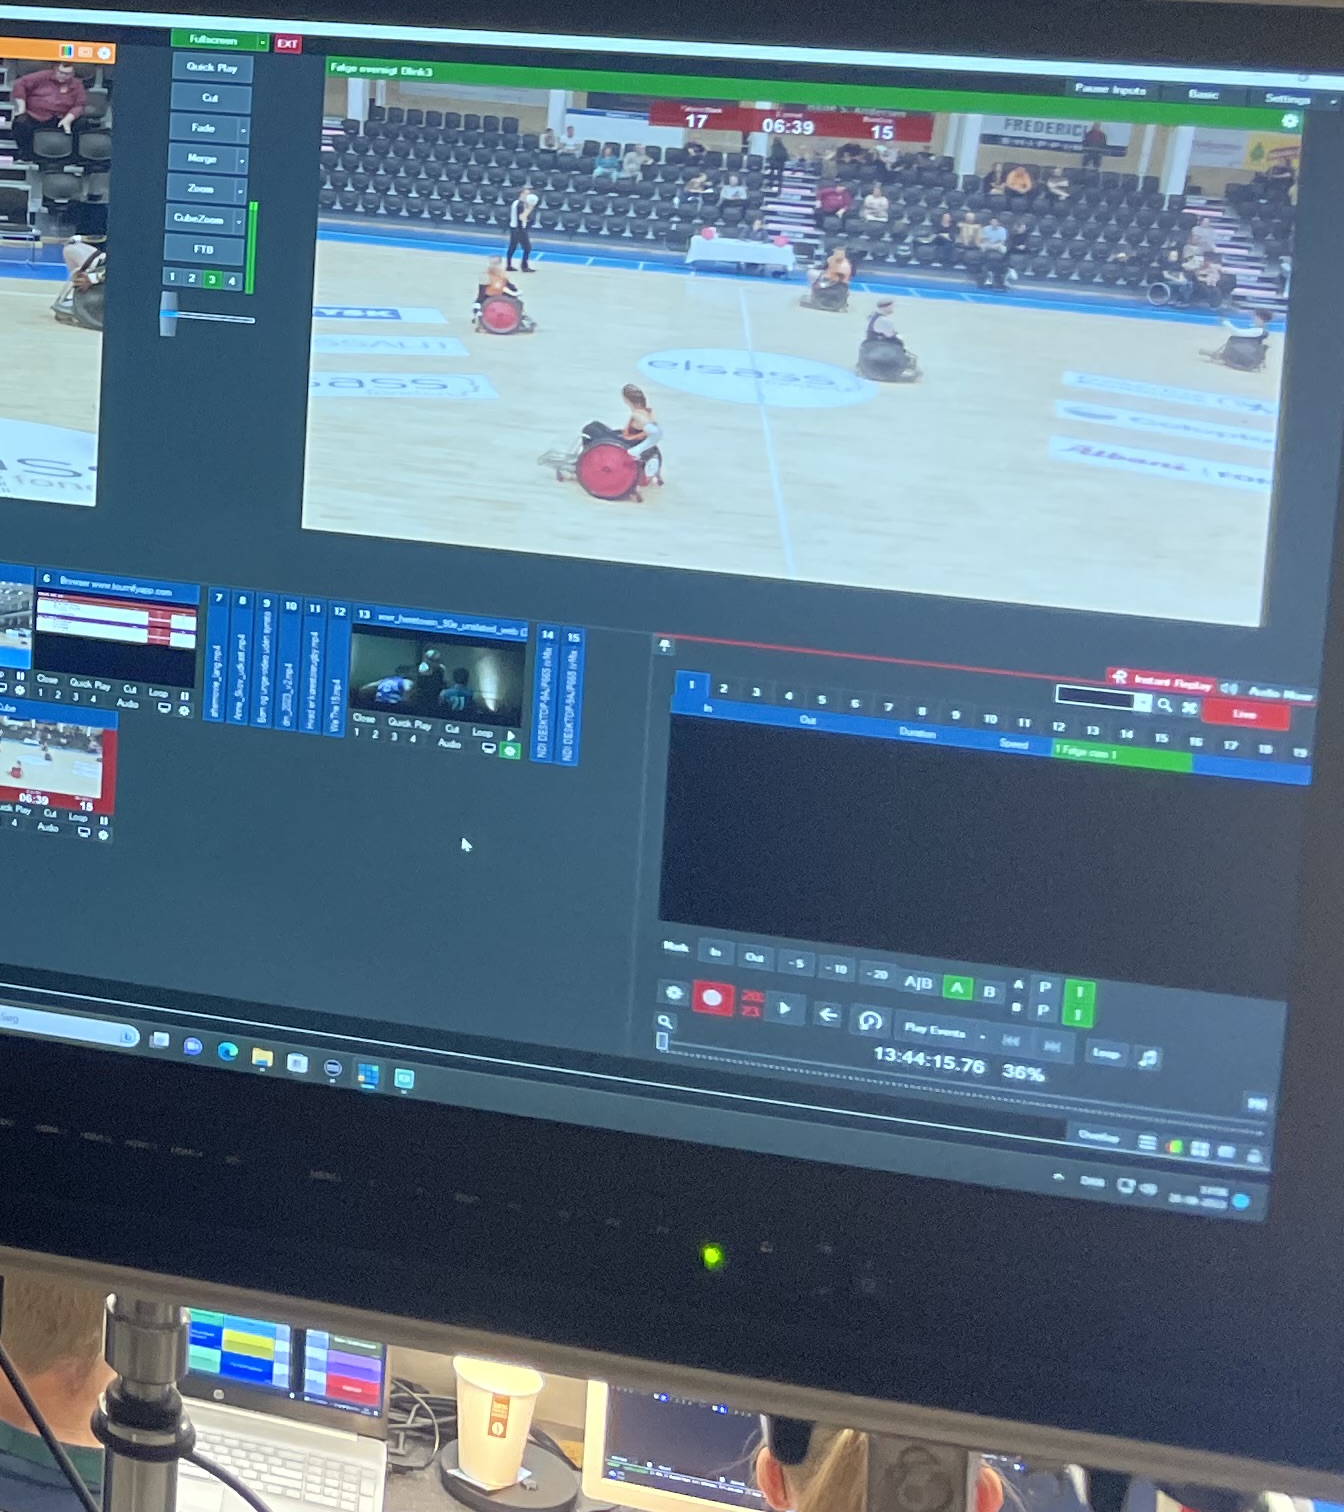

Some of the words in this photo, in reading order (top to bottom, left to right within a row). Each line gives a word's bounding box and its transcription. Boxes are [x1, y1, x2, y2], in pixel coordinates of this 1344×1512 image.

[189, 34, 238, 47] Fullscreen
[277, 38, 298, 50] EXT
[186, 61, 212, 75] Quick
[215, 62, 238, 76] Play
[202, 92, 219, 105] Cut
[1075, 82, 1109, 95] Pause
[1113, 85, 1146, 98] Inputs
[1188, 89, 1219, 101] Basic
[1265, 93, 1311, 107] Settings
[191, 121, 216, 135] Fade
[685, 114, 708, 129] 17
[763, 118, 814, 135] 06:39
[871, 125, 894, 140] 15
[187, 152, 217, 166] Merge
[187, 183, 214, 196] Zoom
[174, 213, 224, 226] CubeZoom
[193, 243, 214, 256] FTB
[285, 601, 297, 611] 10
[309, 603, 321, 613] 11
[334, 606, 346, 616] 12
[358, 609, 371, 619] 13
[542, 630, 554, 640] 14
[567, 633, 580, 642] 15
[1135, 674, 1170, 687] Instant
[1175, 679, 1212, 692] Replay
[353, 713, 376, 724] Close
[388, 716, 412, 729] Quick
[414, 720, 431, 732] Play
[445, 723, 459, 735] Cut
[472, 727, 493, 739] Loop
[437, 738, 461, 750] Audio
[1000, 737, 1028, 750] Speed
[745, 951, 764, 964] Out
[951, 982, 963, 994] A
[984, 986, 995, 998] B
[905, 1020, 927, 1034] Play
[930, 1025, 966, 1039] Events
[874, 1046, 986, 1075] 13:44:15.76
[1002, 1063, 1046, 1082] 36%
